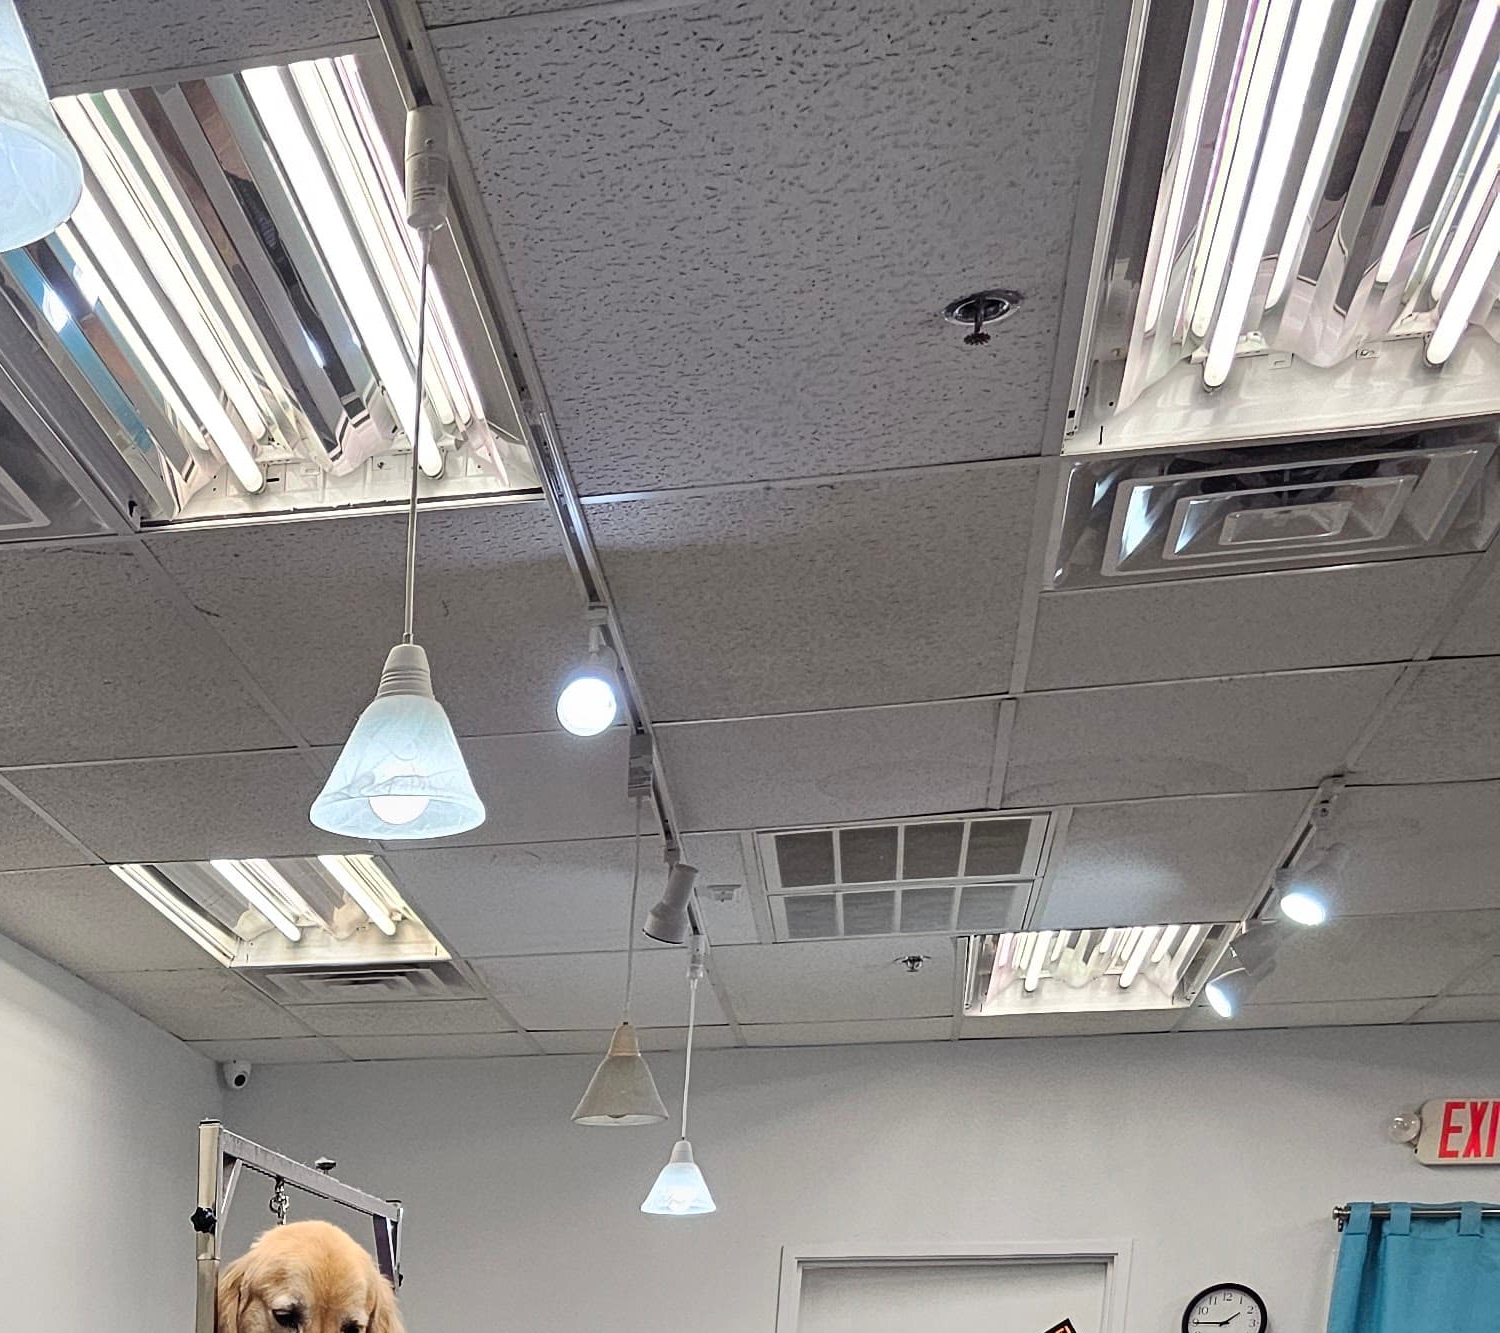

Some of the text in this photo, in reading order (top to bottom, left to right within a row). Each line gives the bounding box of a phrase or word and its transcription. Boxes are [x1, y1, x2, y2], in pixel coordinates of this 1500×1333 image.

[1438, 1101, 1500, 1158] EXI
[1209, 1295, 1218, 1305] 11
[1223, 1292, 1233, 1301] 12
[1198, 1306, 1209, 1315] 10
[1246, 1305, 1254, 1314] 2
[1248, 1319, 1256, 1327] 3
